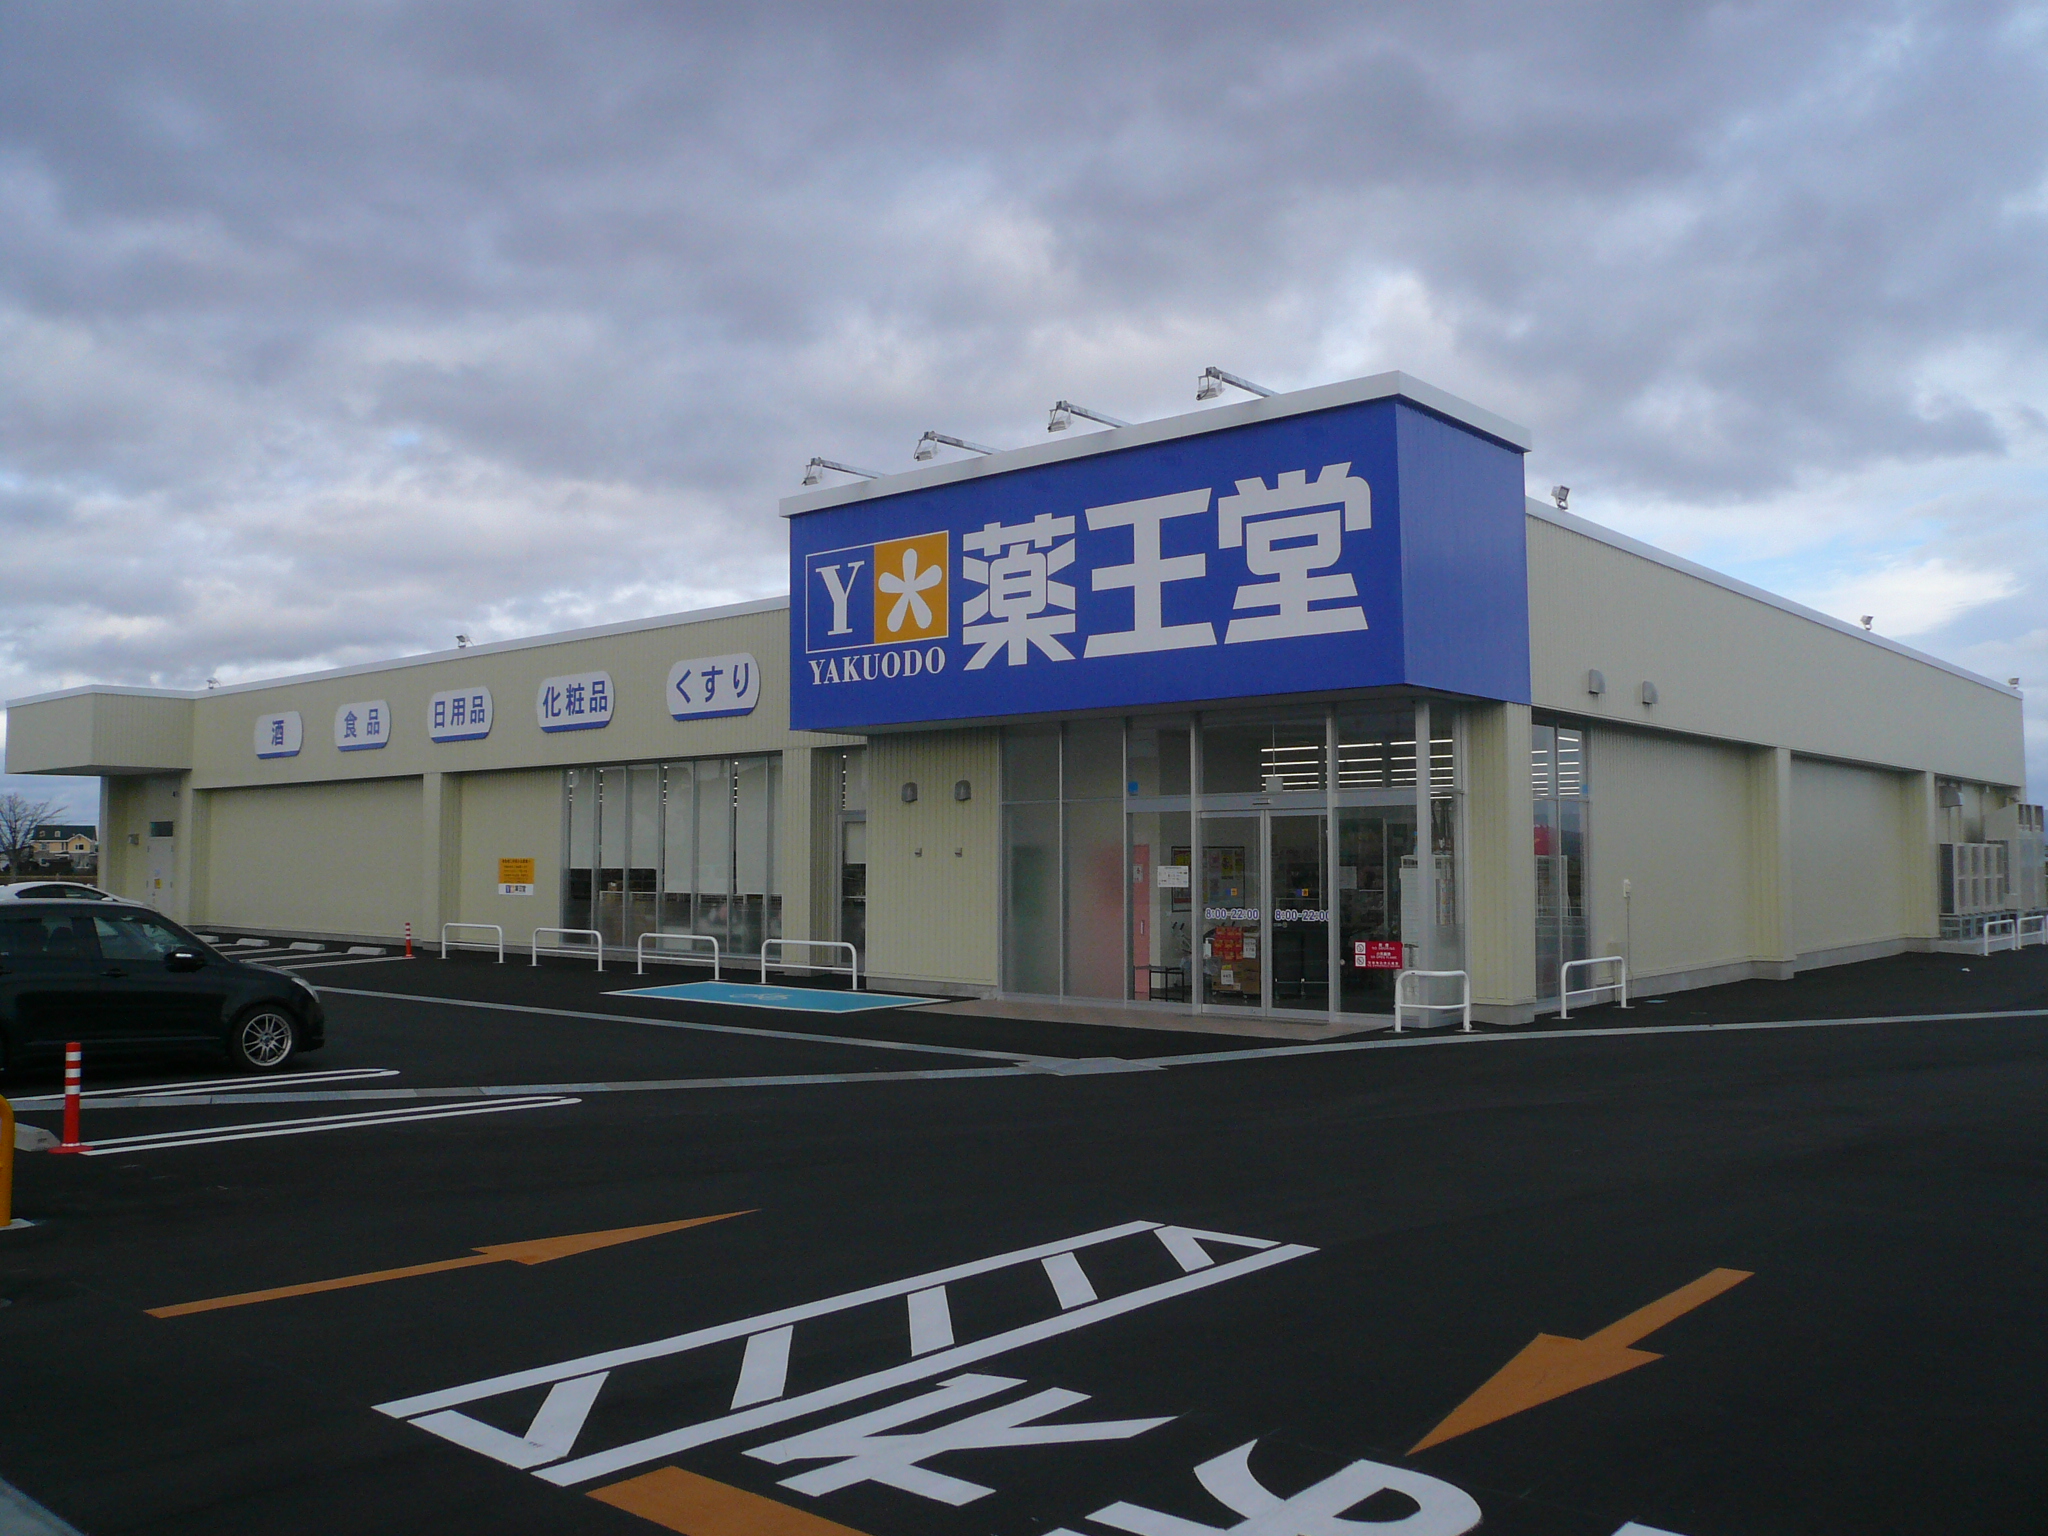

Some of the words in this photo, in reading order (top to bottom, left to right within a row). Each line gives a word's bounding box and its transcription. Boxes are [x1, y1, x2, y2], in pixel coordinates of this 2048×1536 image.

[962, 461, 1372, 671] 薬王堂
[815, 561, 865, 637] Y
[675, 661, 751, 705] くすり
[808, 646, 946, 686] YAKUODO
[433, 694, 486, 729] 日用品
[542, 680, 608, 719] 化粧品
[270, 718, 285, 746] 酒
[343, 707, 381, 739] 食品
[1205, 908, 1259, 919] 8:00-22:00
